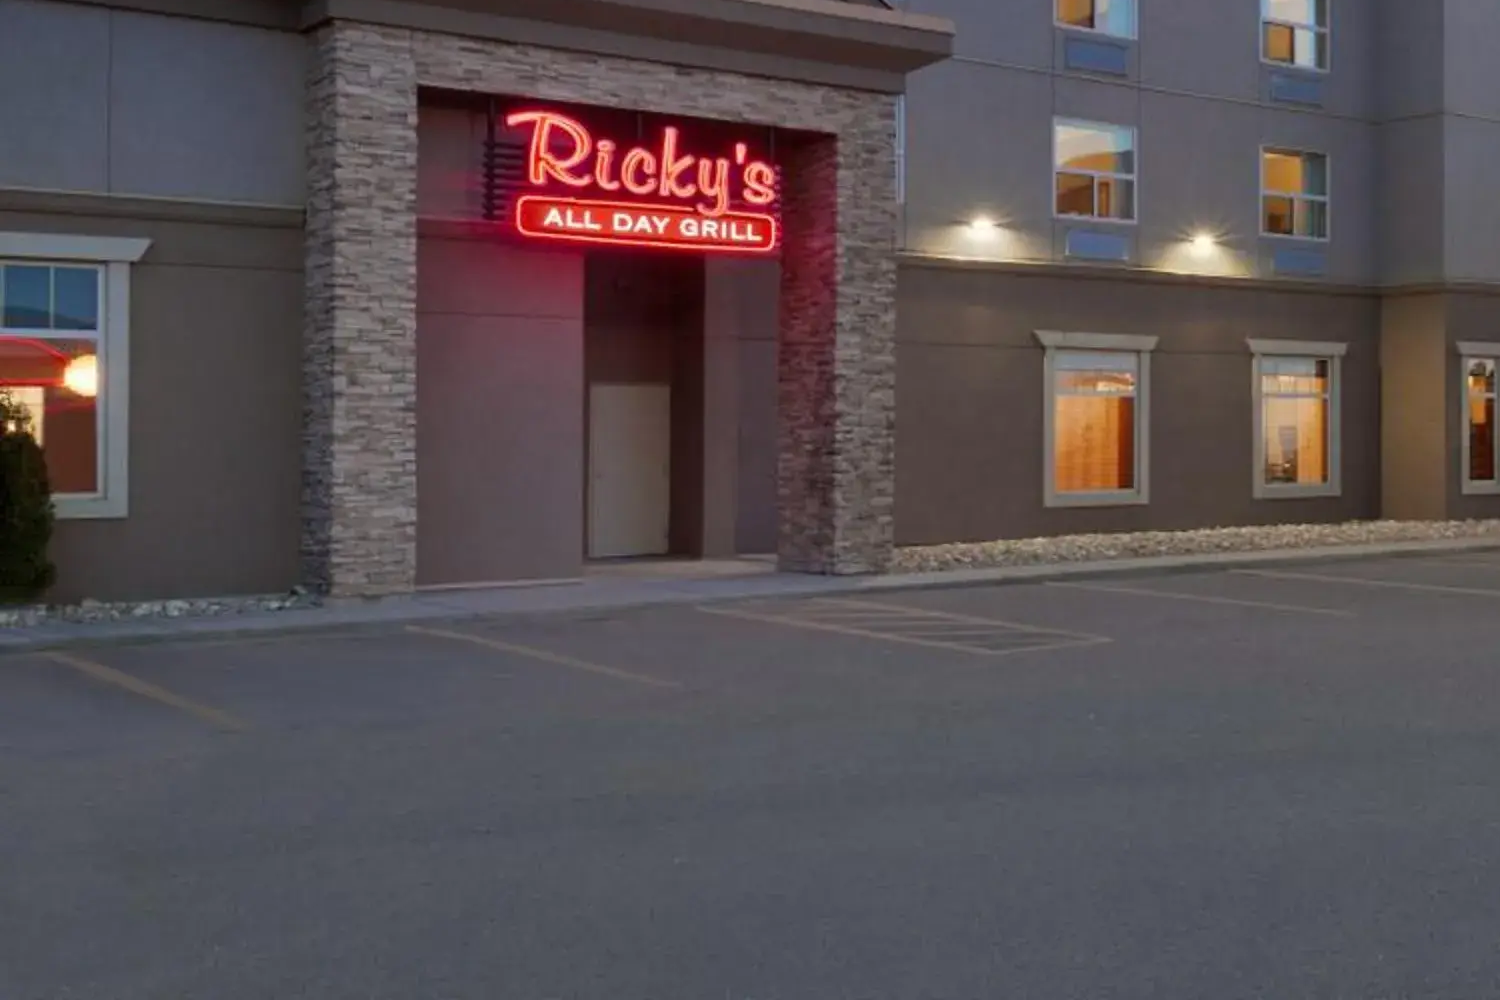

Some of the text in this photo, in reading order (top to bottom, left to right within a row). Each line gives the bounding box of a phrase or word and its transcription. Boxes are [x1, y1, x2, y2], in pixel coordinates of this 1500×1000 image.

[507, 111, 776, 216] Ricky's
[543, 208, 763, 242] ALL DAY GRILL
